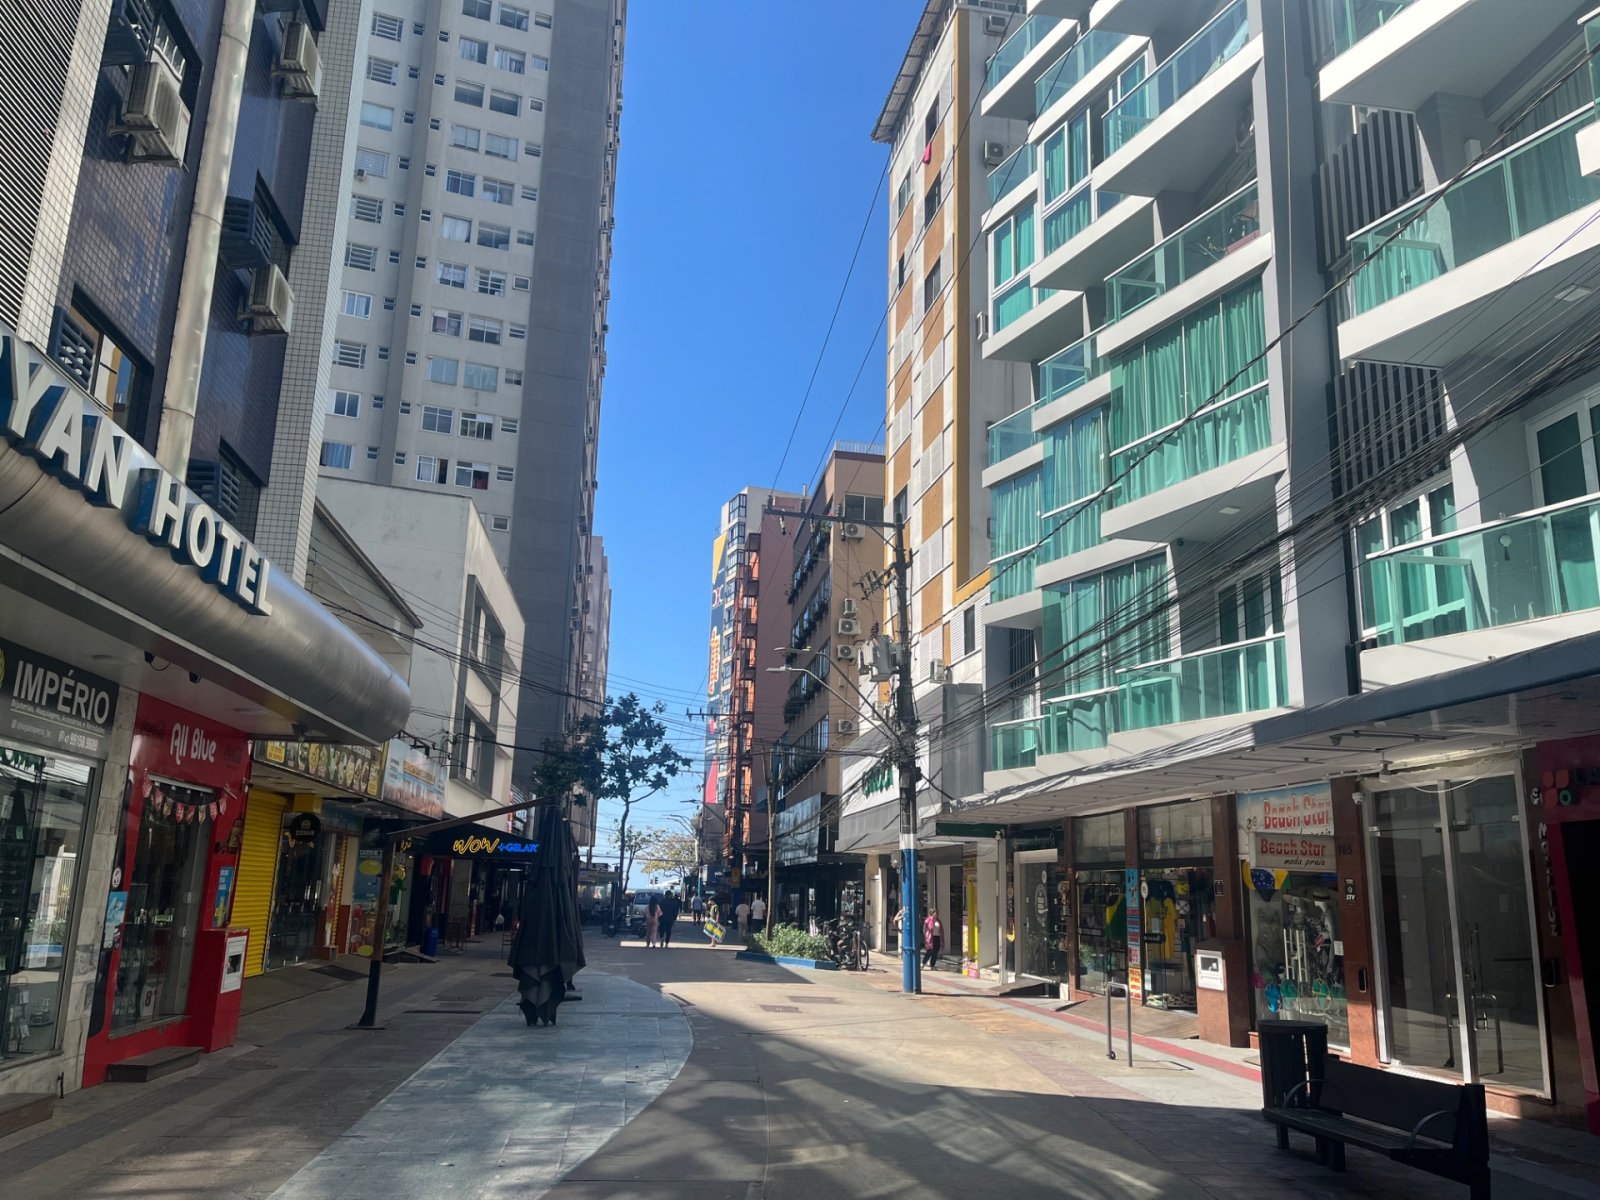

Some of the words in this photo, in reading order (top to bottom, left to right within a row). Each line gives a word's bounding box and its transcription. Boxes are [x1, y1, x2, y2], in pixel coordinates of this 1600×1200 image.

[0, 334, 133, 510] YAN
[148, 468, 272, 616] HOTEL
[13, 660, 110, 724] IMPÉRIO
[169, 722, 189, 766] All
[191, 727, 217, 763] Blue
[452, 835, 500, 855] WOW
[1260, 838, 1298, 856] Beach
[1300, 839, 1327, 857] Star
[1283, 857, 1302, 866] moda
